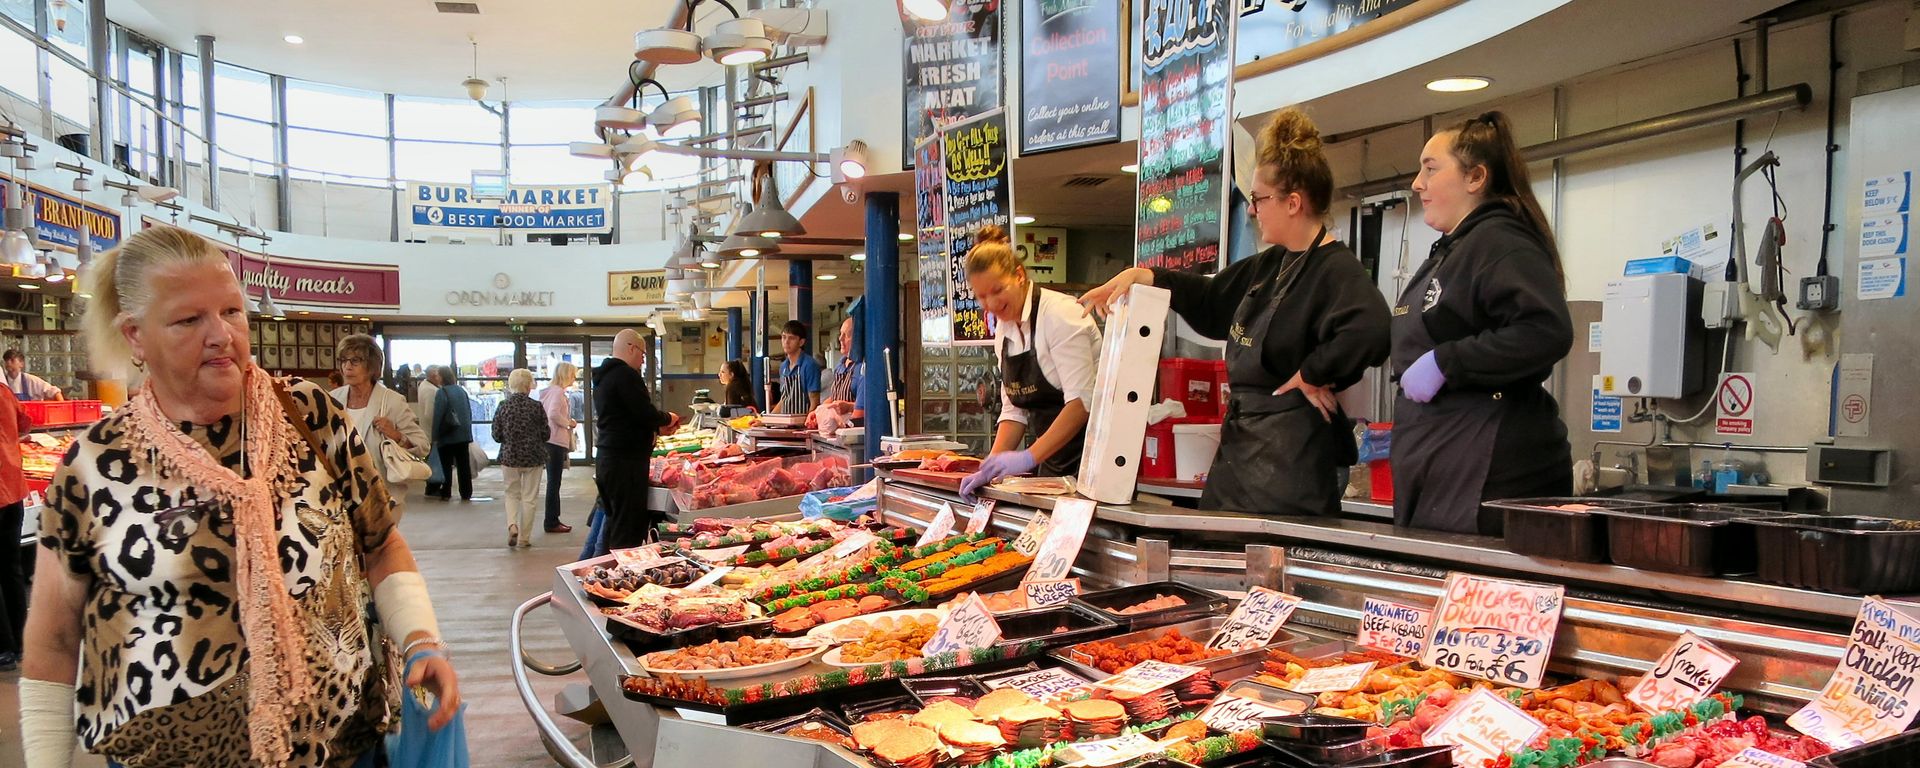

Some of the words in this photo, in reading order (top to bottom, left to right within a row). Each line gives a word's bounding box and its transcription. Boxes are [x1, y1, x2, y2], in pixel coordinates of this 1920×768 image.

[1286, 22, 1304, 40] For
[1310, 3, 1356, 38] Quality
[911, 36, 991, 64] MARKET
[1031, 26, 1108, 57] Collection
[921, 61, 980, 86] FRESH
[1047, 59, 1088, 84] Point
[925, 86, 976, 109] MEAT
[1028, 104, 1057, 122] Collect
[1057, 105, 1079, 123] your
[1081, 97, 1109, 113] online
[1029, 129, 1055, 145] orders
[1056, 128, 1067, 140] at
[1068, 124, 1085, 139] this
[1087, 120, 1110, 136] stall
[500, 188, 599, 205] MARKET
[1172, 193, 1205, 211] URGERS
[1864, 198, 1886, 207] BELOW
[1865, 189, 1879, 198] KEEP
[449, 214, 488, 226] BEST
[543, 214, 602, 227] MARKET
[500, 205, 536, 213] WINNER
[537, 205, 550, 214] OF
[1863, 231, 1875, 239] KEEP
[1877, 236, 1896, 245] CLOSED
[242, 265, 291, 296] quality
[296, 276, 355, 295] meats
[631, 276, 664, 290] BURY
[446, 290, 493, 307] OPEN
[494, 290, 556, 308] MARKET
[1026, 583, 1073, 598] CHICKEN
[1034, 588, 1075, 605] BREAST
[1450, 577, 1536, 621] CHICKEN
[1240, 608, 1276, 625] STYLE
[1364, 601, 1419, 623] MARINATED
[1863, 601, 1896, 631] Fresh
[1363, 614, 1391, 632] BEEF
[1391, 621, 1427, 639] KEBABS
[1434, 626, 1461, 647] 10
[1465, 633, 1490, 649] FOR
[1853, 620, 1887, 650] Salt
[1368, 632, 1378, 645] 5
[1394, 637, 1421, 656] 2.99
[1435, 648, 1460, 668] 20
[1485, 654, 1529, 684] £6
[1846, 643, 1915, 697] Chicken
[999, 671, 1052, 687] TENDER
[1212, 697, 1265, 722] THICK
[1853, 677, 1909, 720] Wings
